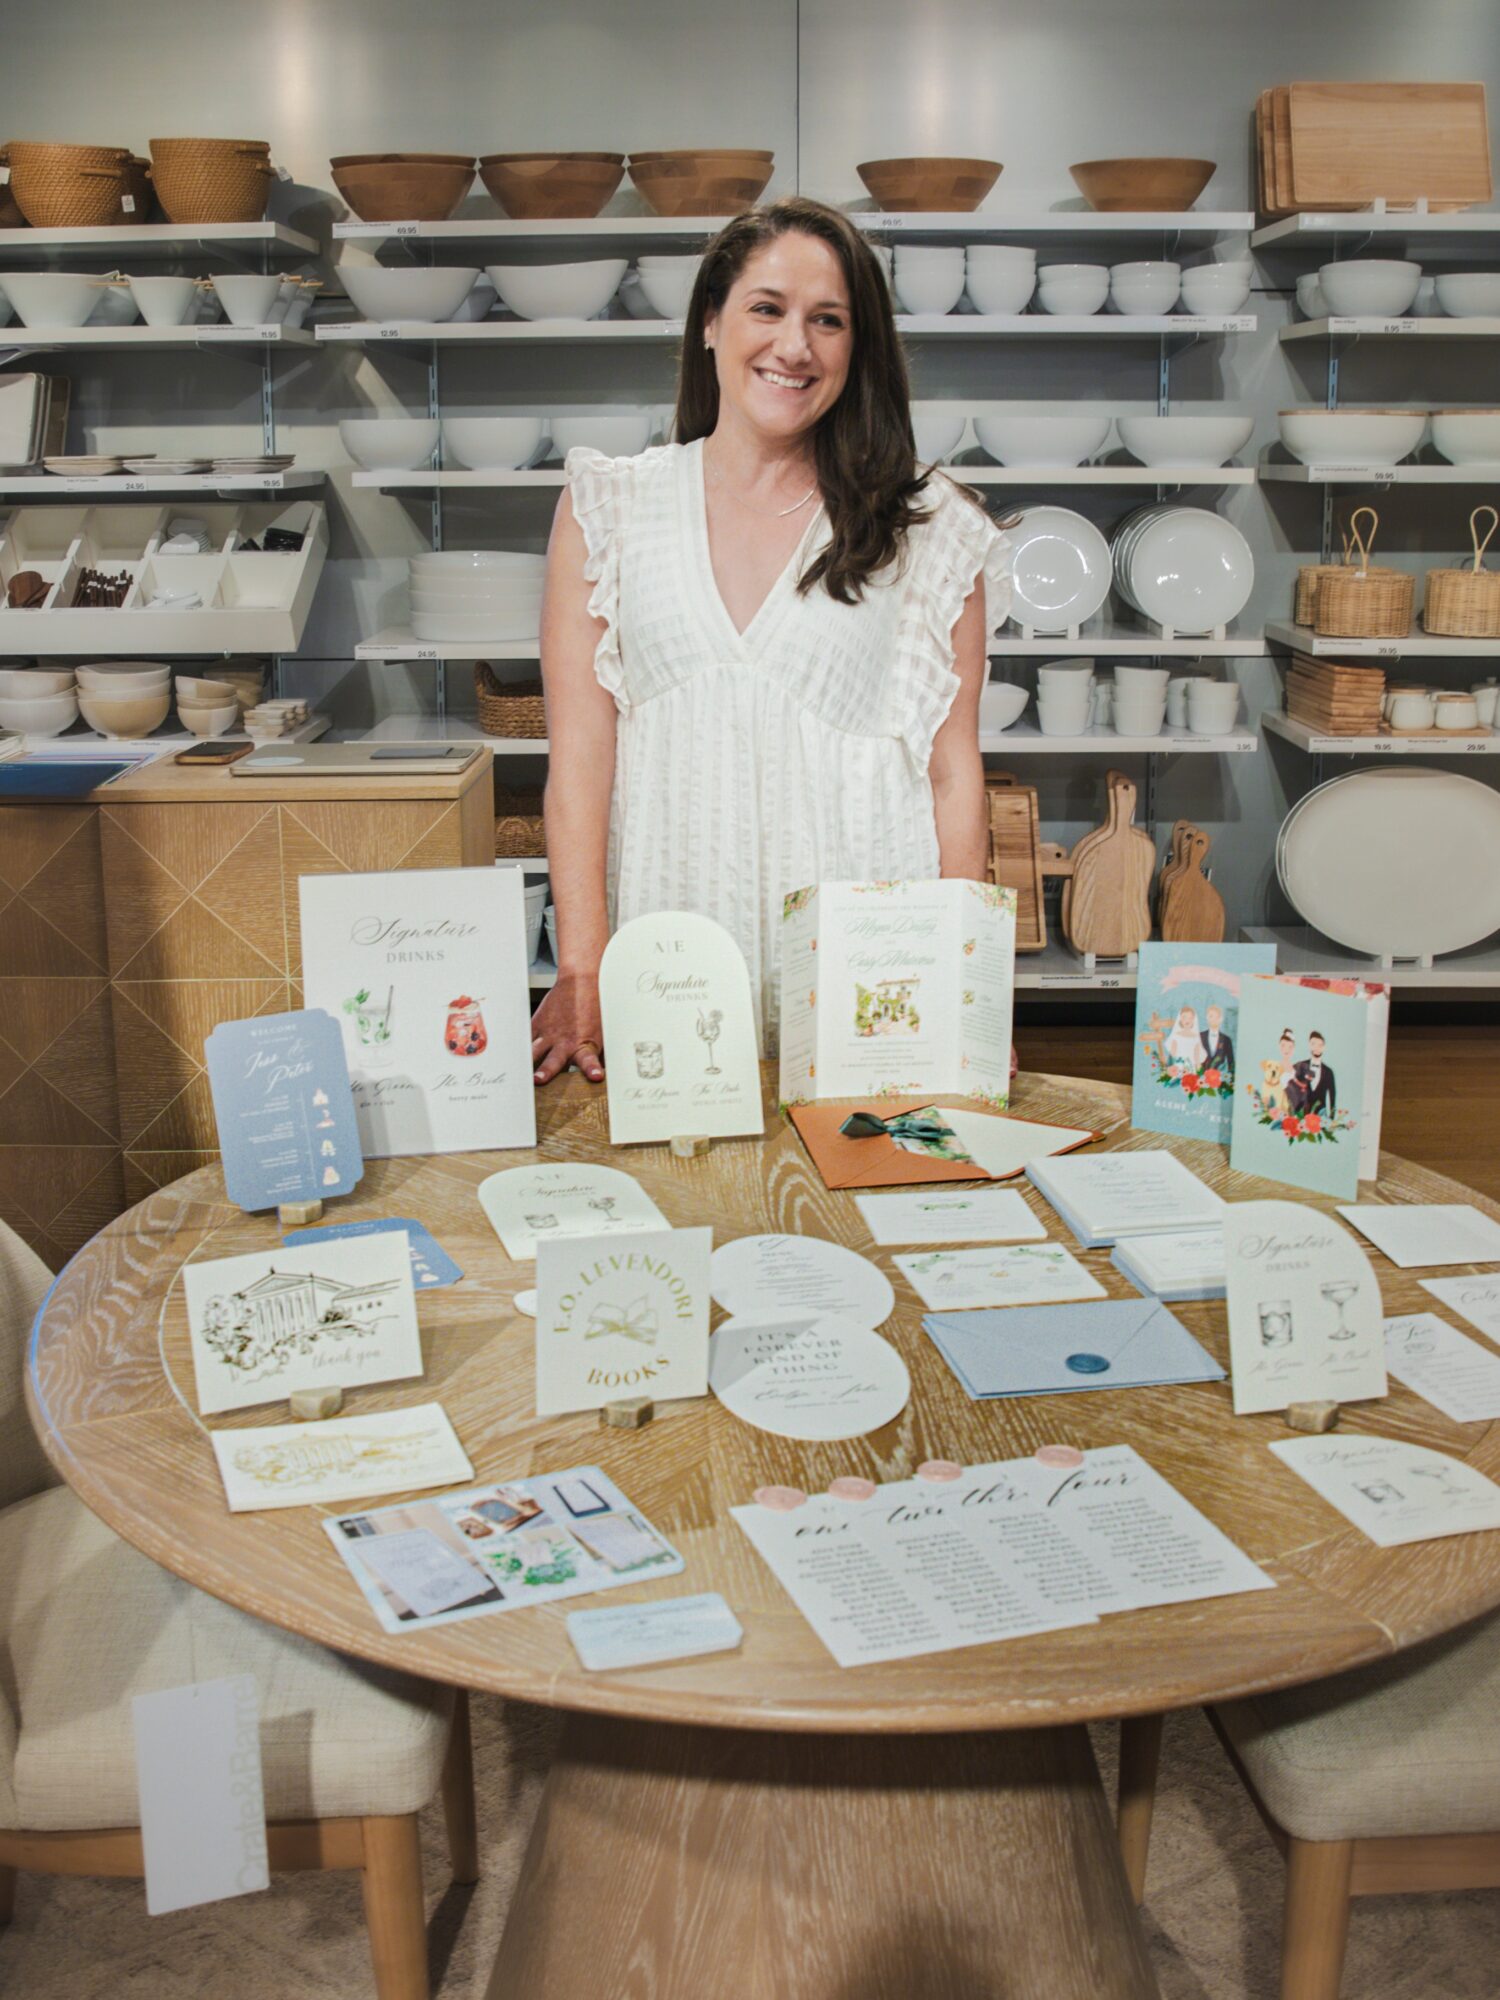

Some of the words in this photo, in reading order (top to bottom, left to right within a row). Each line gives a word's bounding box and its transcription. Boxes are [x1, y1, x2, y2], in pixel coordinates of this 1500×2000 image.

[350, 916, 481, 948] Signature
[386, 949, 446, 965] DRINKS
[636, 969, 709, 999] Signature
[666, 991, 709, 1003] DRINKS
[1238, 1234, 1335, 1260] Signature
[1265, 1260, 1311, 1273] DRINKS
[743, 1338, 843, 1355] FOREVER
[312, 1346, 352, 1369] thank
[357, 1349, 382, 1370] you
[753, 1353, 806, 1365] KIND
[814, 1350, 843, 1360] OF
[586, 1353, 671, 1388] BOOKS
[771, 1363, 839, 1375] THING
[1047, 1470, 1139, 1508] four
